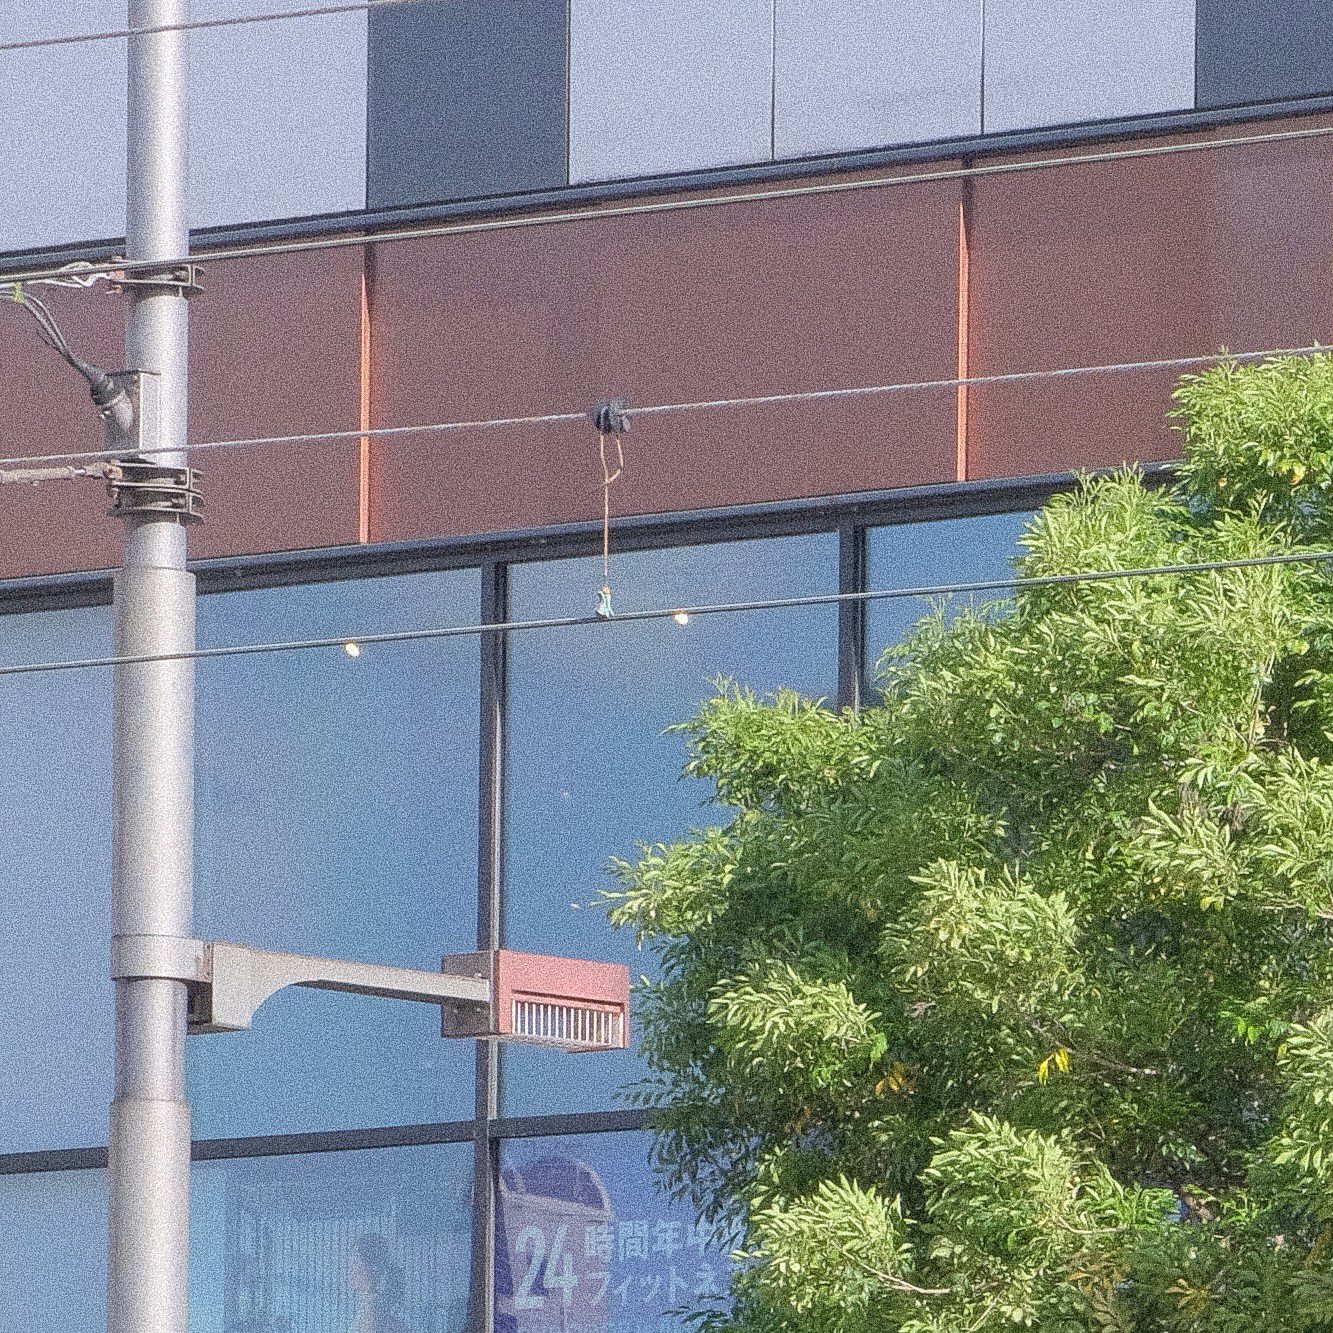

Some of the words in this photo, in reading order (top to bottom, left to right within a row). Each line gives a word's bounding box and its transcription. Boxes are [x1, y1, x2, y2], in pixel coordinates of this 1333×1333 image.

[514, 1224, 578, 1311] 24
[584, 1262, 722, 1307] フィットネ
